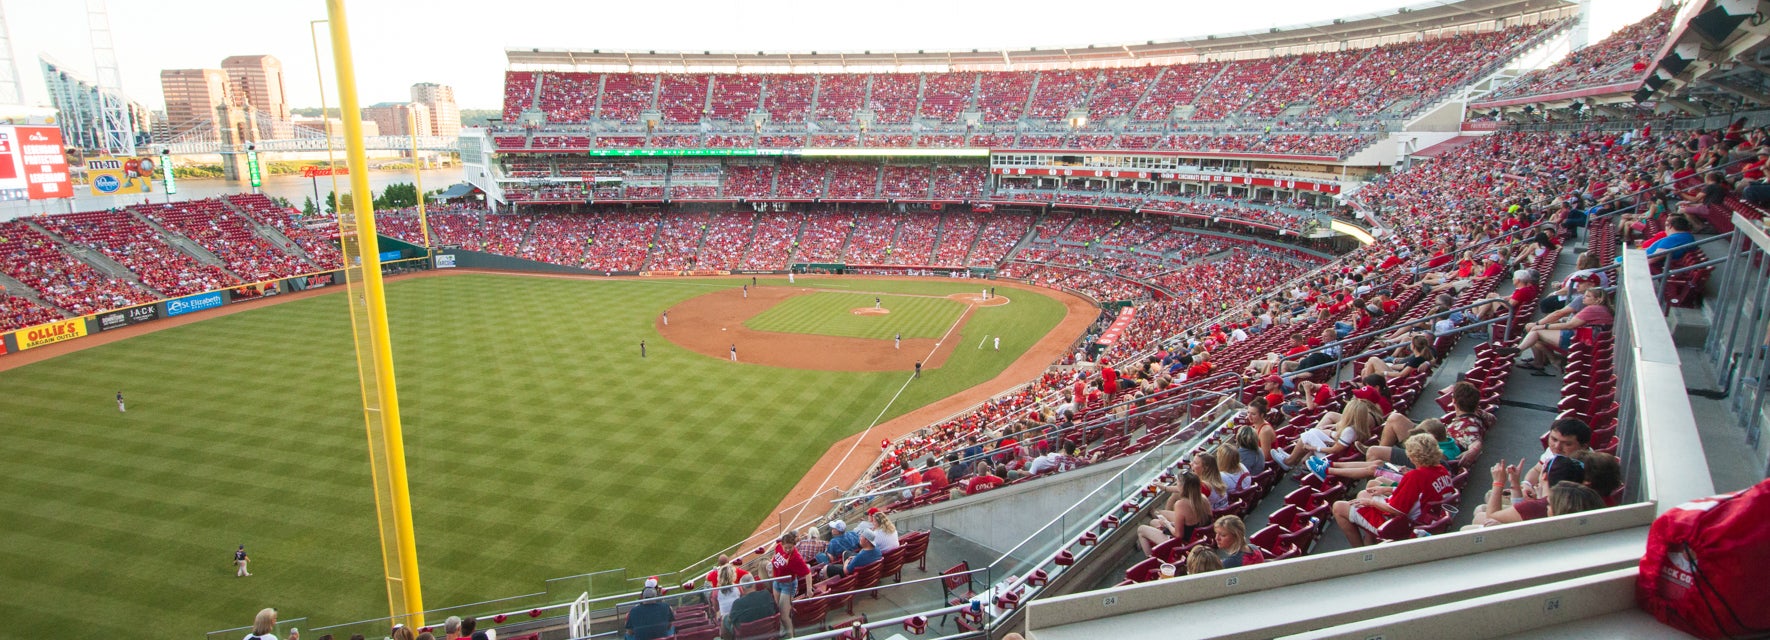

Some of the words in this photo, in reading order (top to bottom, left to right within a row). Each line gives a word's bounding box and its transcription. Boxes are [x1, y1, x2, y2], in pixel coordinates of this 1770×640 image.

[130, 306, 155, 318] JACK
[28, 322, 76, 341] OLLIE'S
[26, 337, 55, 348] BARGAIN
[56, 332, 79, 341] OUTLET
